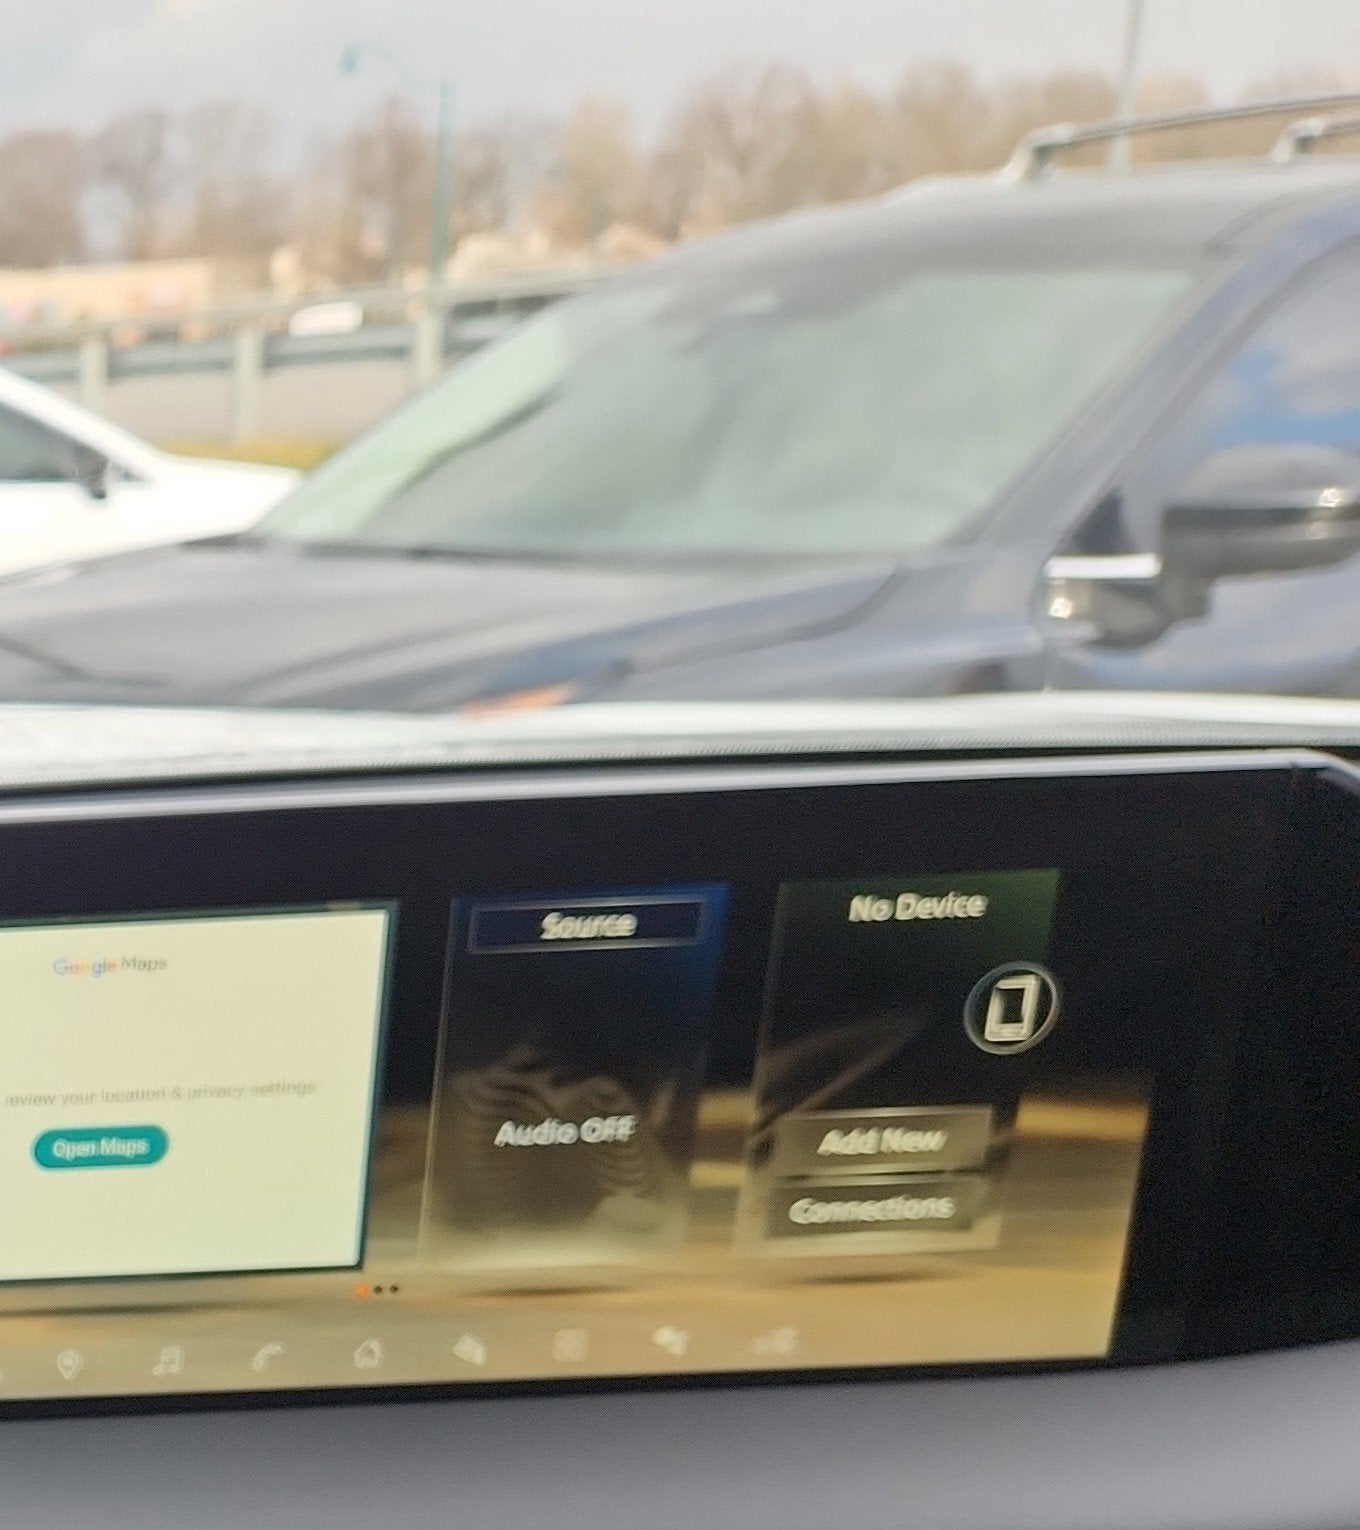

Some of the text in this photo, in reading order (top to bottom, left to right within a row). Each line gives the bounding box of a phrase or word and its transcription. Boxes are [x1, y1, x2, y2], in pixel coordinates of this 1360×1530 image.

[848, 891, 989, 922] No Device
[541, 912, 639, 940] Source
[52, 955, 168, 978] Google Maps
[4, 1091, 57, 1107] review
[59, 1091, 95, 1109] your
[100, 1087, 167, 1104] location
[186, 1082, 245, 1102] privacy
[250, 1078, 317, 1098] settings
[494, 1117, 579, 1147] Audio
[817, 1127, 948, 1155] Add New
[52, 1136, 150, 1162] Open Maps
[789, 1196, 956, 1224] Connections
